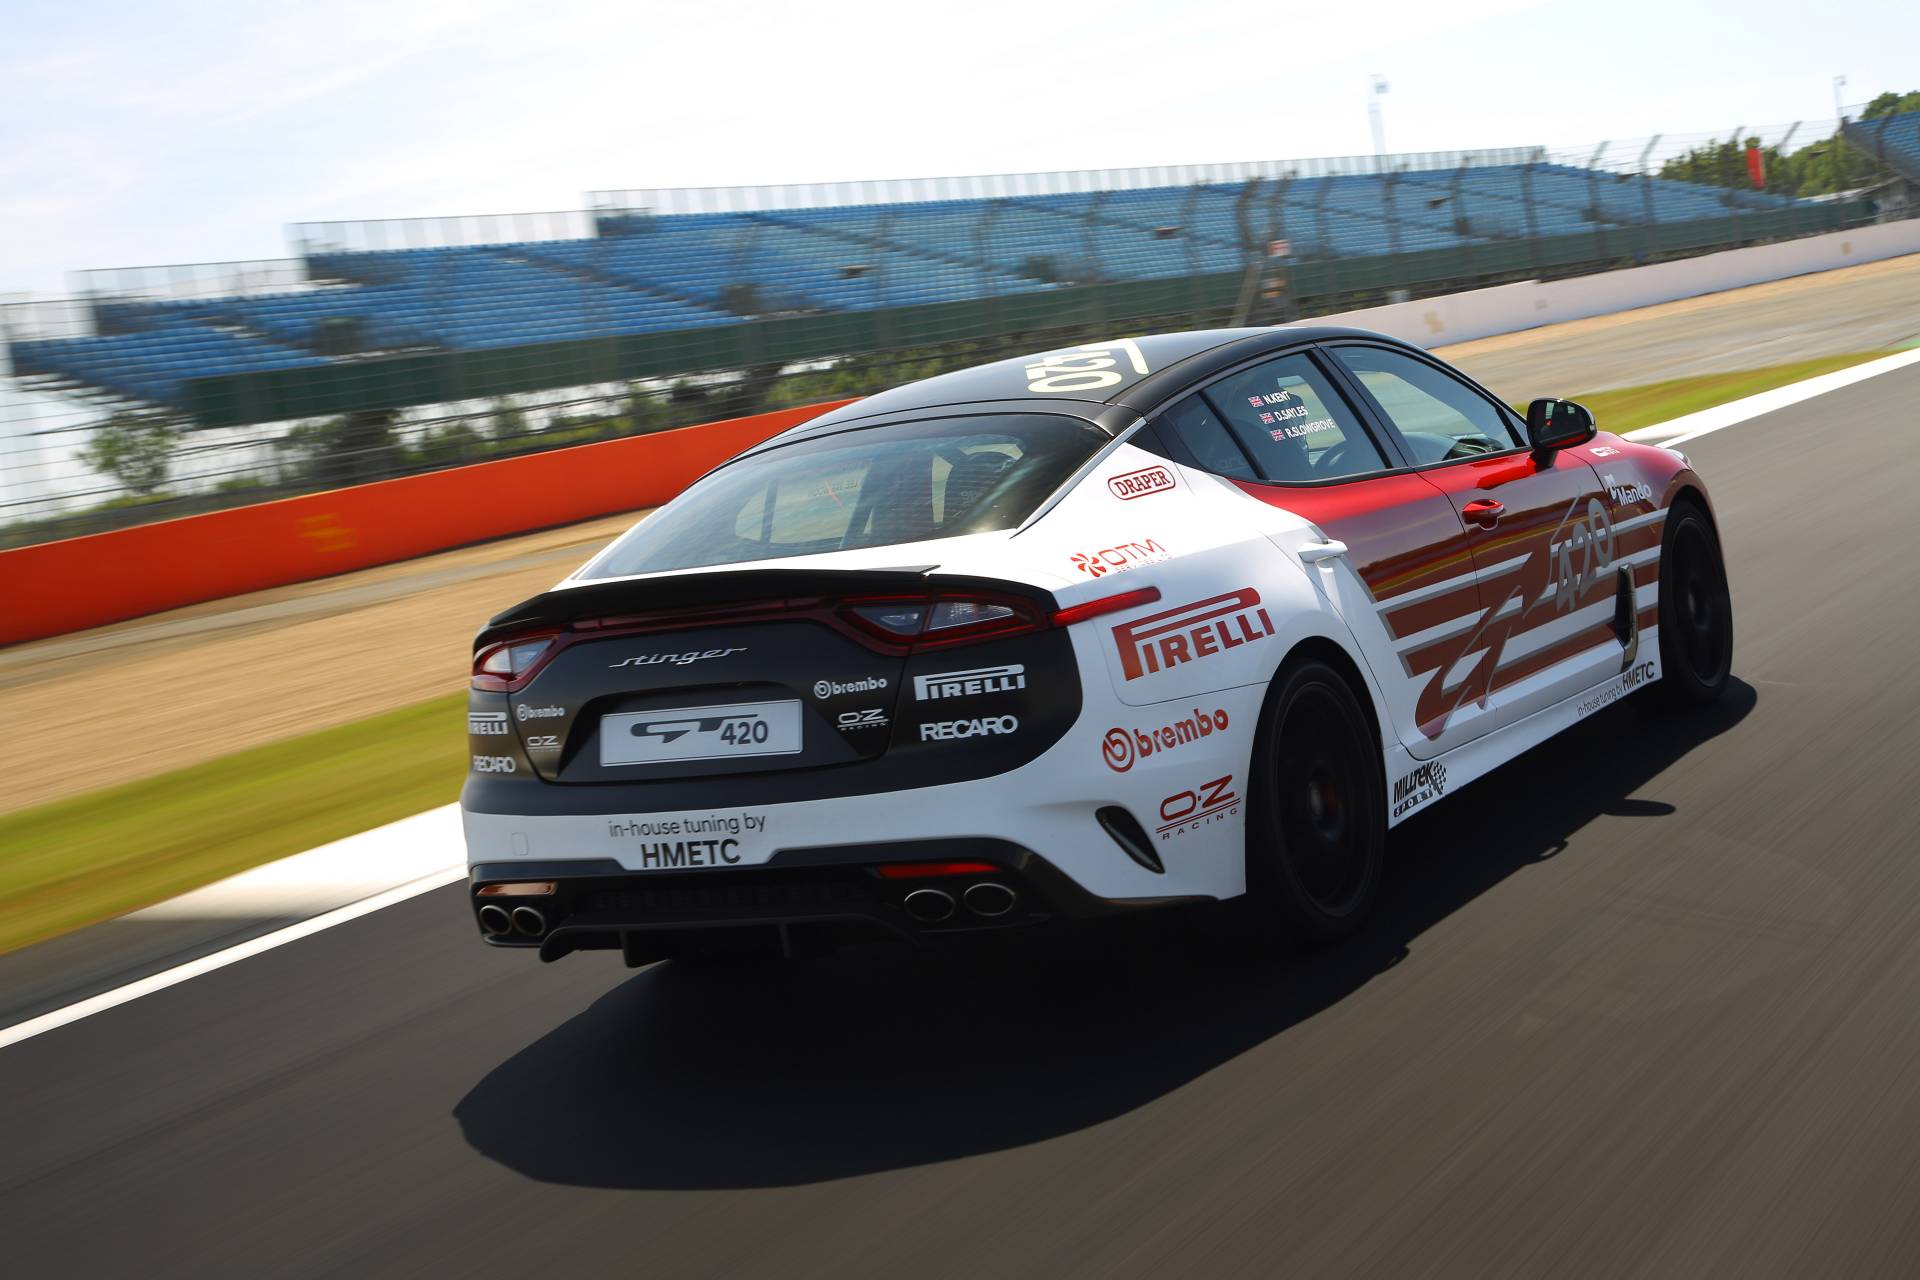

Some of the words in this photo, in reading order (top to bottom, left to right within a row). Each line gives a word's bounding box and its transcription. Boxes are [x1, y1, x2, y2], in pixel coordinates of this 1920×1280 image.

[1262, 390, 1291, 405] N.KENT
[1274, 405, 1309, 422] D.SAYLES
[1284, 418, 1336, 439] R.SLOWGROVE
[1114, 470, 1171, 496] DRAPER
[1616, 483, 1652, 506] Mando
[1098, 538, 1166, 566] OTM
[1556, 498, 1614, 611] 420
[1111, 586, 1276, 681] PIRELLI
[608, 647, 748, 668] stinger
[832, 677, 888, 695] brembo
[913, 663, 1026, 701] PIRELLI
[1623, 661, 1655, 691] HMETC
[527, 704, 565, 719] brembo
[720, 720, 769, 745] 420
[919, 714, 1019, 741] RECARO
[1133, 708, 1229, 758] brembo
[473, 755, 516, 773] RECARO
[1394, 789, 1433, 818] SPORT
[608, 820, 680, 838] in-house
[683, 814, 740, 835] tuning
[743, 812, 766, 833] by
[1161, 808, 1238, 841] RACING
[640, 838, 741, 868] HMETC
